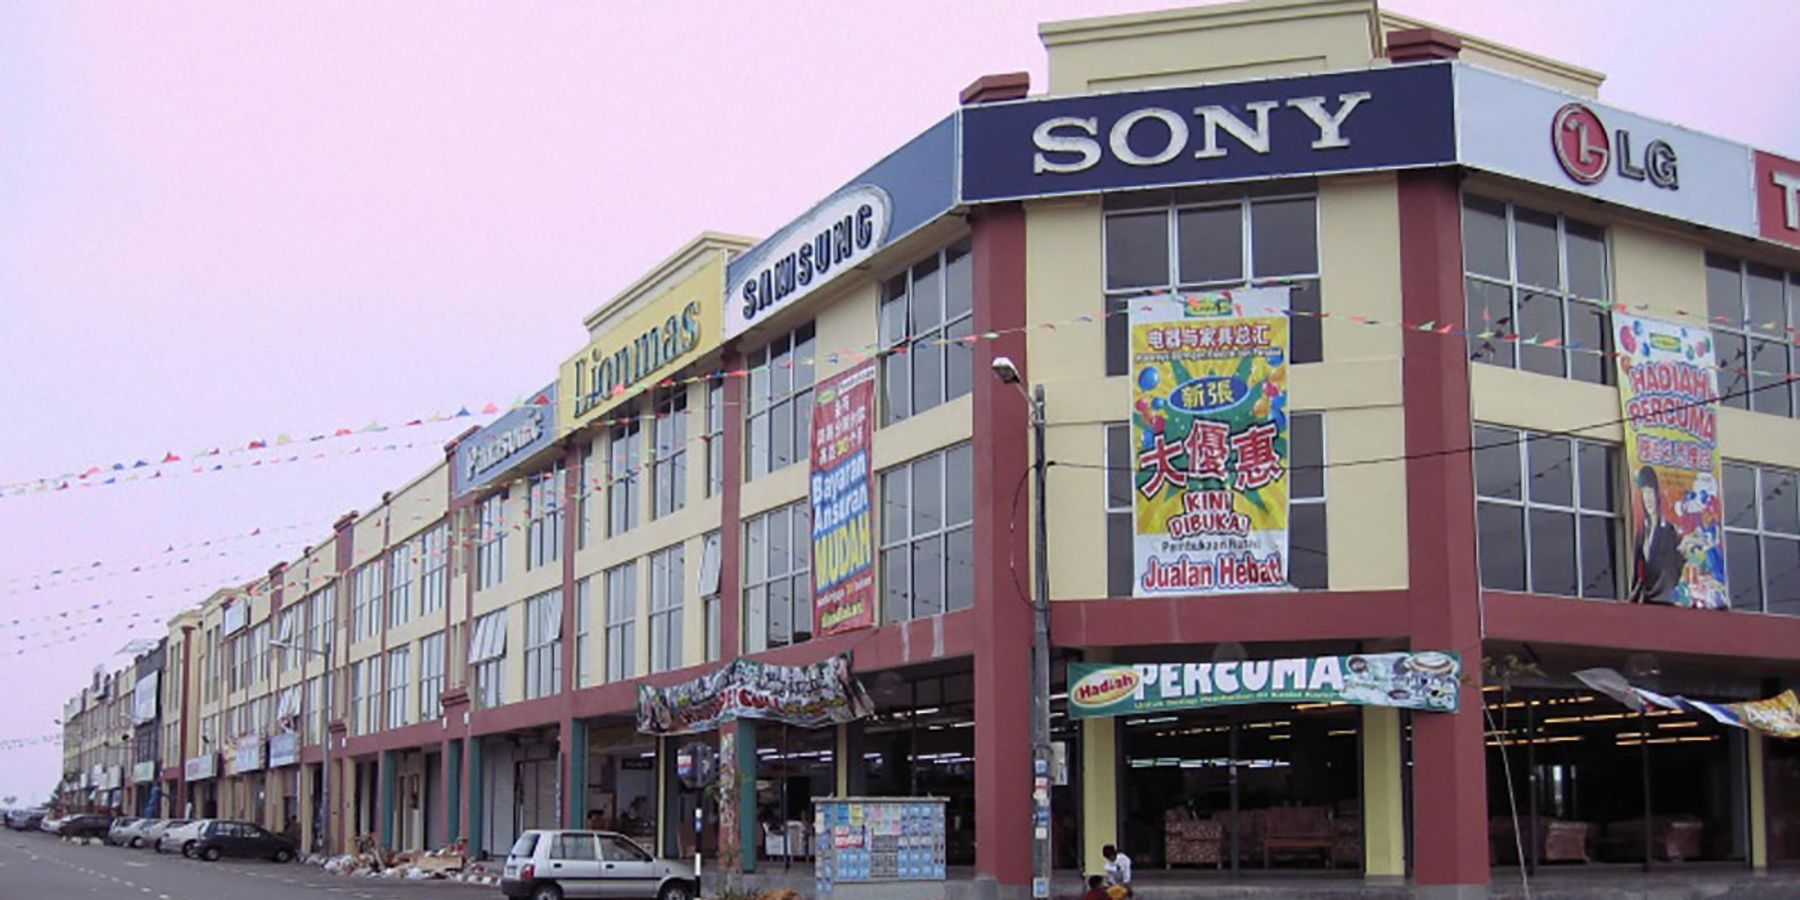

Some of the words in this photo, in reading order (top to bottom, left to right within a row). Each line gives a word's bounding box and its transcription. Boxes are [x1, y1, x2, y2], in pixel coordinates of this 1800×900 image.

[1032, 91, 1371, 174] SONY
[1616, 129, 1679, 191] LG
[742, 204, 873, 319] SAMSUNG
[574, 300, 702, 418] Lionmas
[1181, 380, 1235, 408] 新張
[1628, 397, 1717, 443] PERCUMA
[813, 453, 866, 504] Bayaran
[1139, 419, 1284, 498] 大優惠
[813, 483, 868, 535] Ansuran
[1169, 514, 1250, 537] DIBUKA!
[1185, 491, 1231, 512] KINI
[814, 511, 871, 590] MUDAH
[1145, 558, 1212, 589] Jualan
[1219, 553, 1285, 585] Hebat!
[1079, 674, 1134, 699] Hadiah
[1132, 655, 1345, 701] PERCUMA
